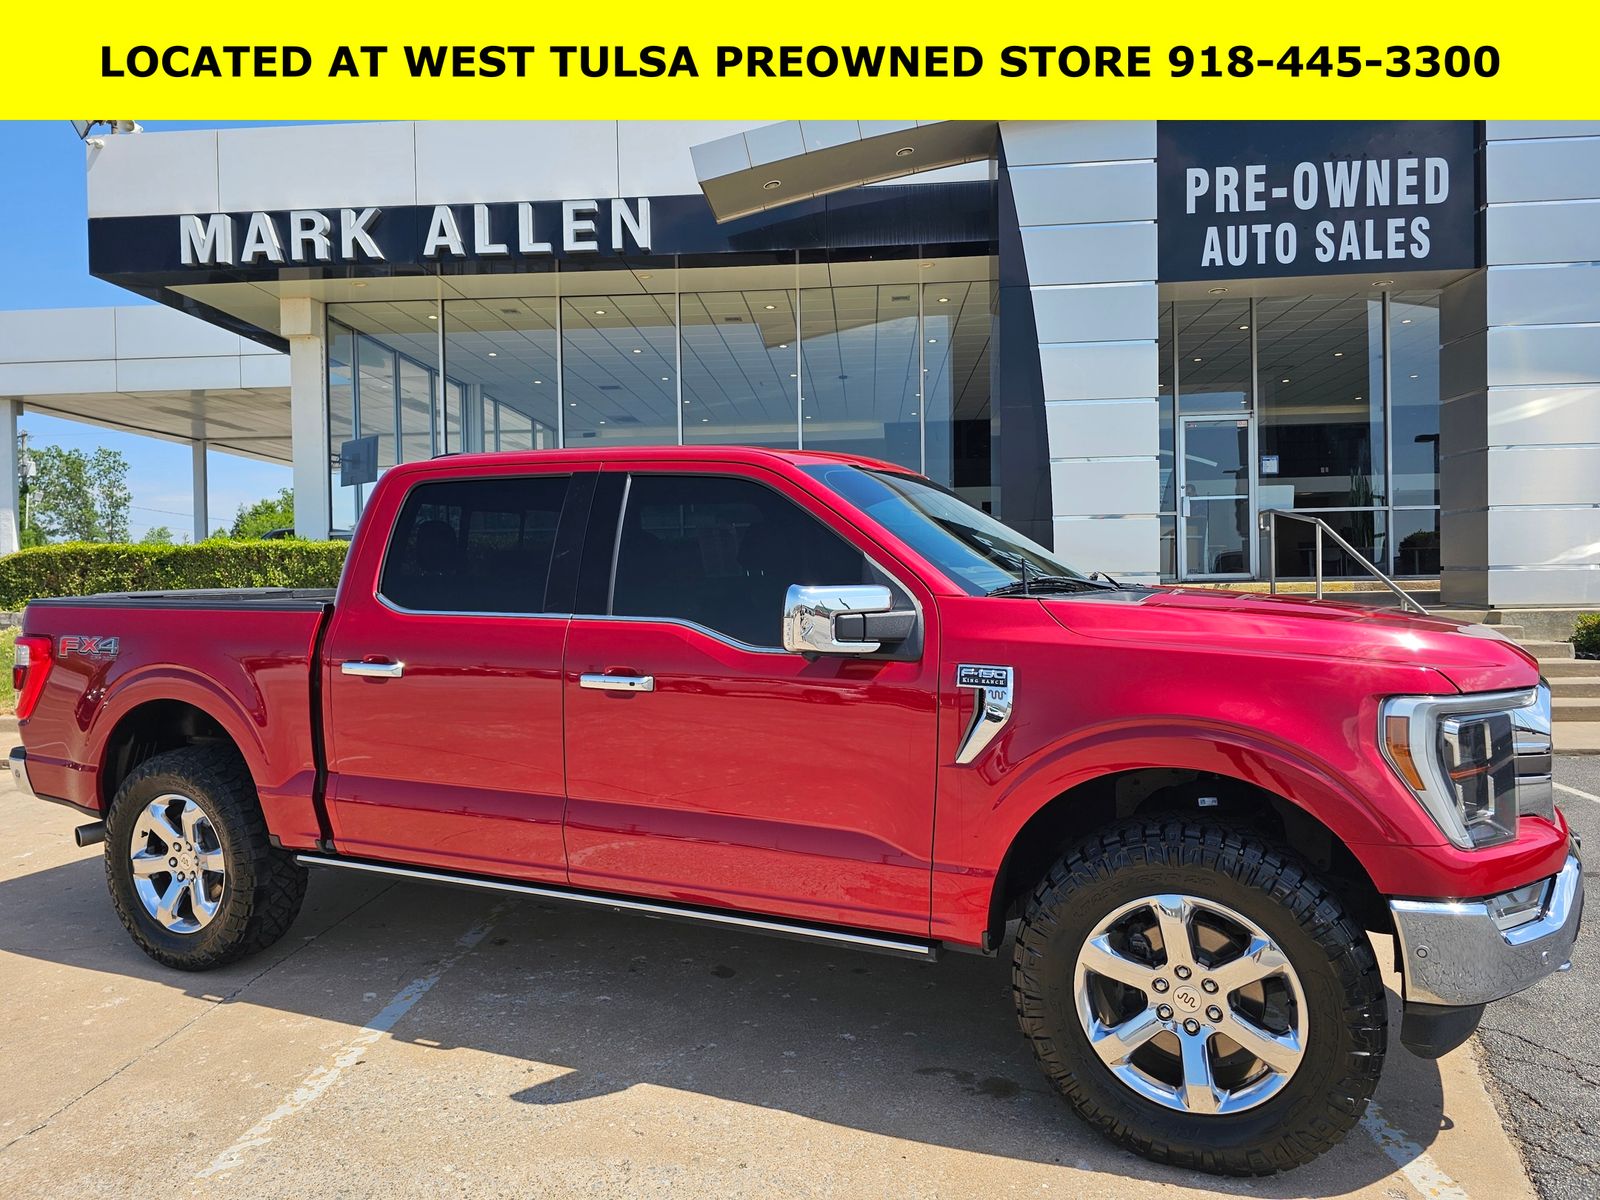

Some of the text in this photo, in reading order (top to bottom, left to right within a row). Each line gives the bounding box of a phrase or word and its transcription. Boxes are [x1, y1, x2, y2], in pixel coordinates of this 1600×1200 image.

[1186, 157, 1450, 214] PRE-OWNED
[179, 197, 652, 266] MARK ALLEN
[1201, 216, 1431, 267] AUTO SALES
[59, 636, 120, 658] FX4
[961, 668, 1006, 679] F-150
